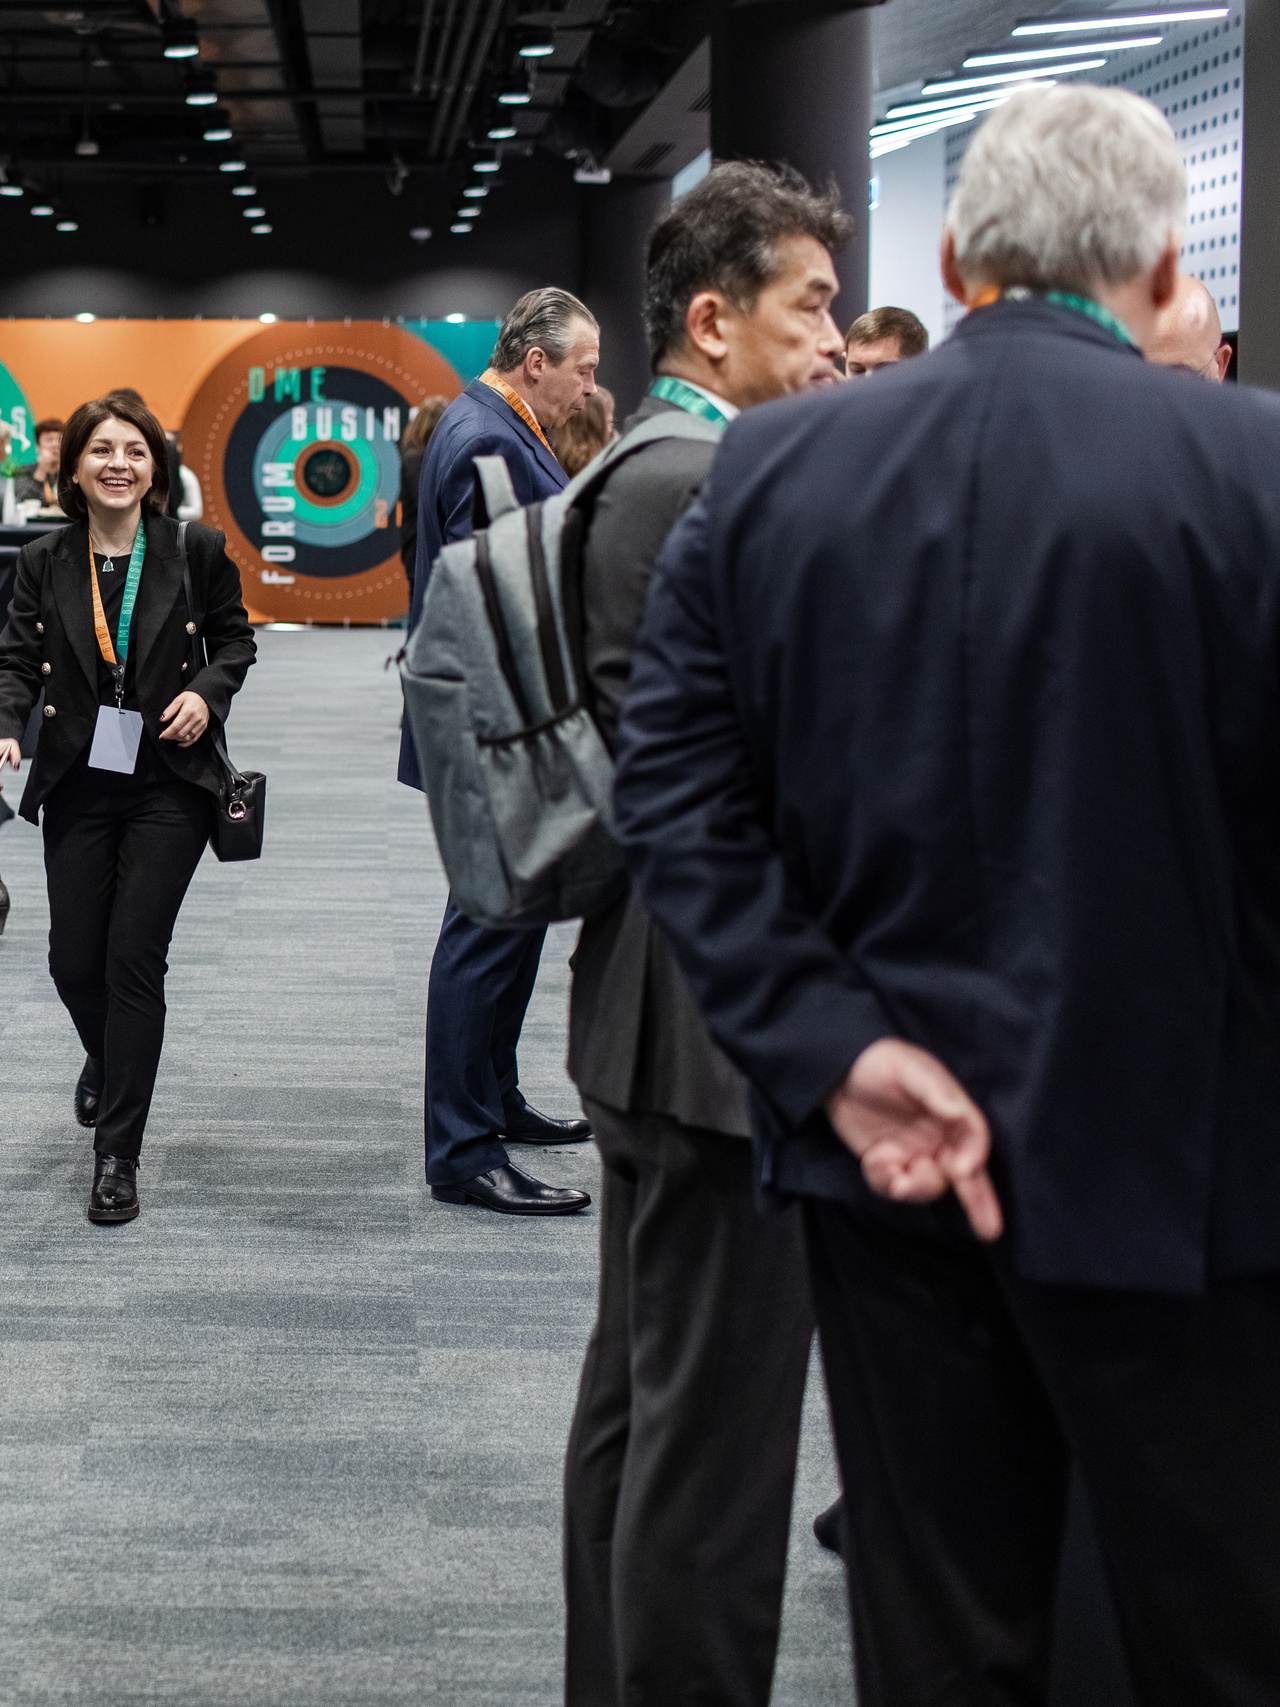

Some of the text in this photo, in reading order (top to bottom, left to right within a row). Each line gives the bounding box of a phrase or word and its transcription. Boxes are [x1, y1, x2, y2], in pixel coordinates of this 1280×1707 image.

[248, 366, 326, 402] DME
[291, 406, 420, 441] BUSIN
[261, 462, 296, 585] FORUM
[121, 560, 141, 615] BUSINESS
[95, 625, 112, 654] 2019
[118, 622, 130, 646] DME
